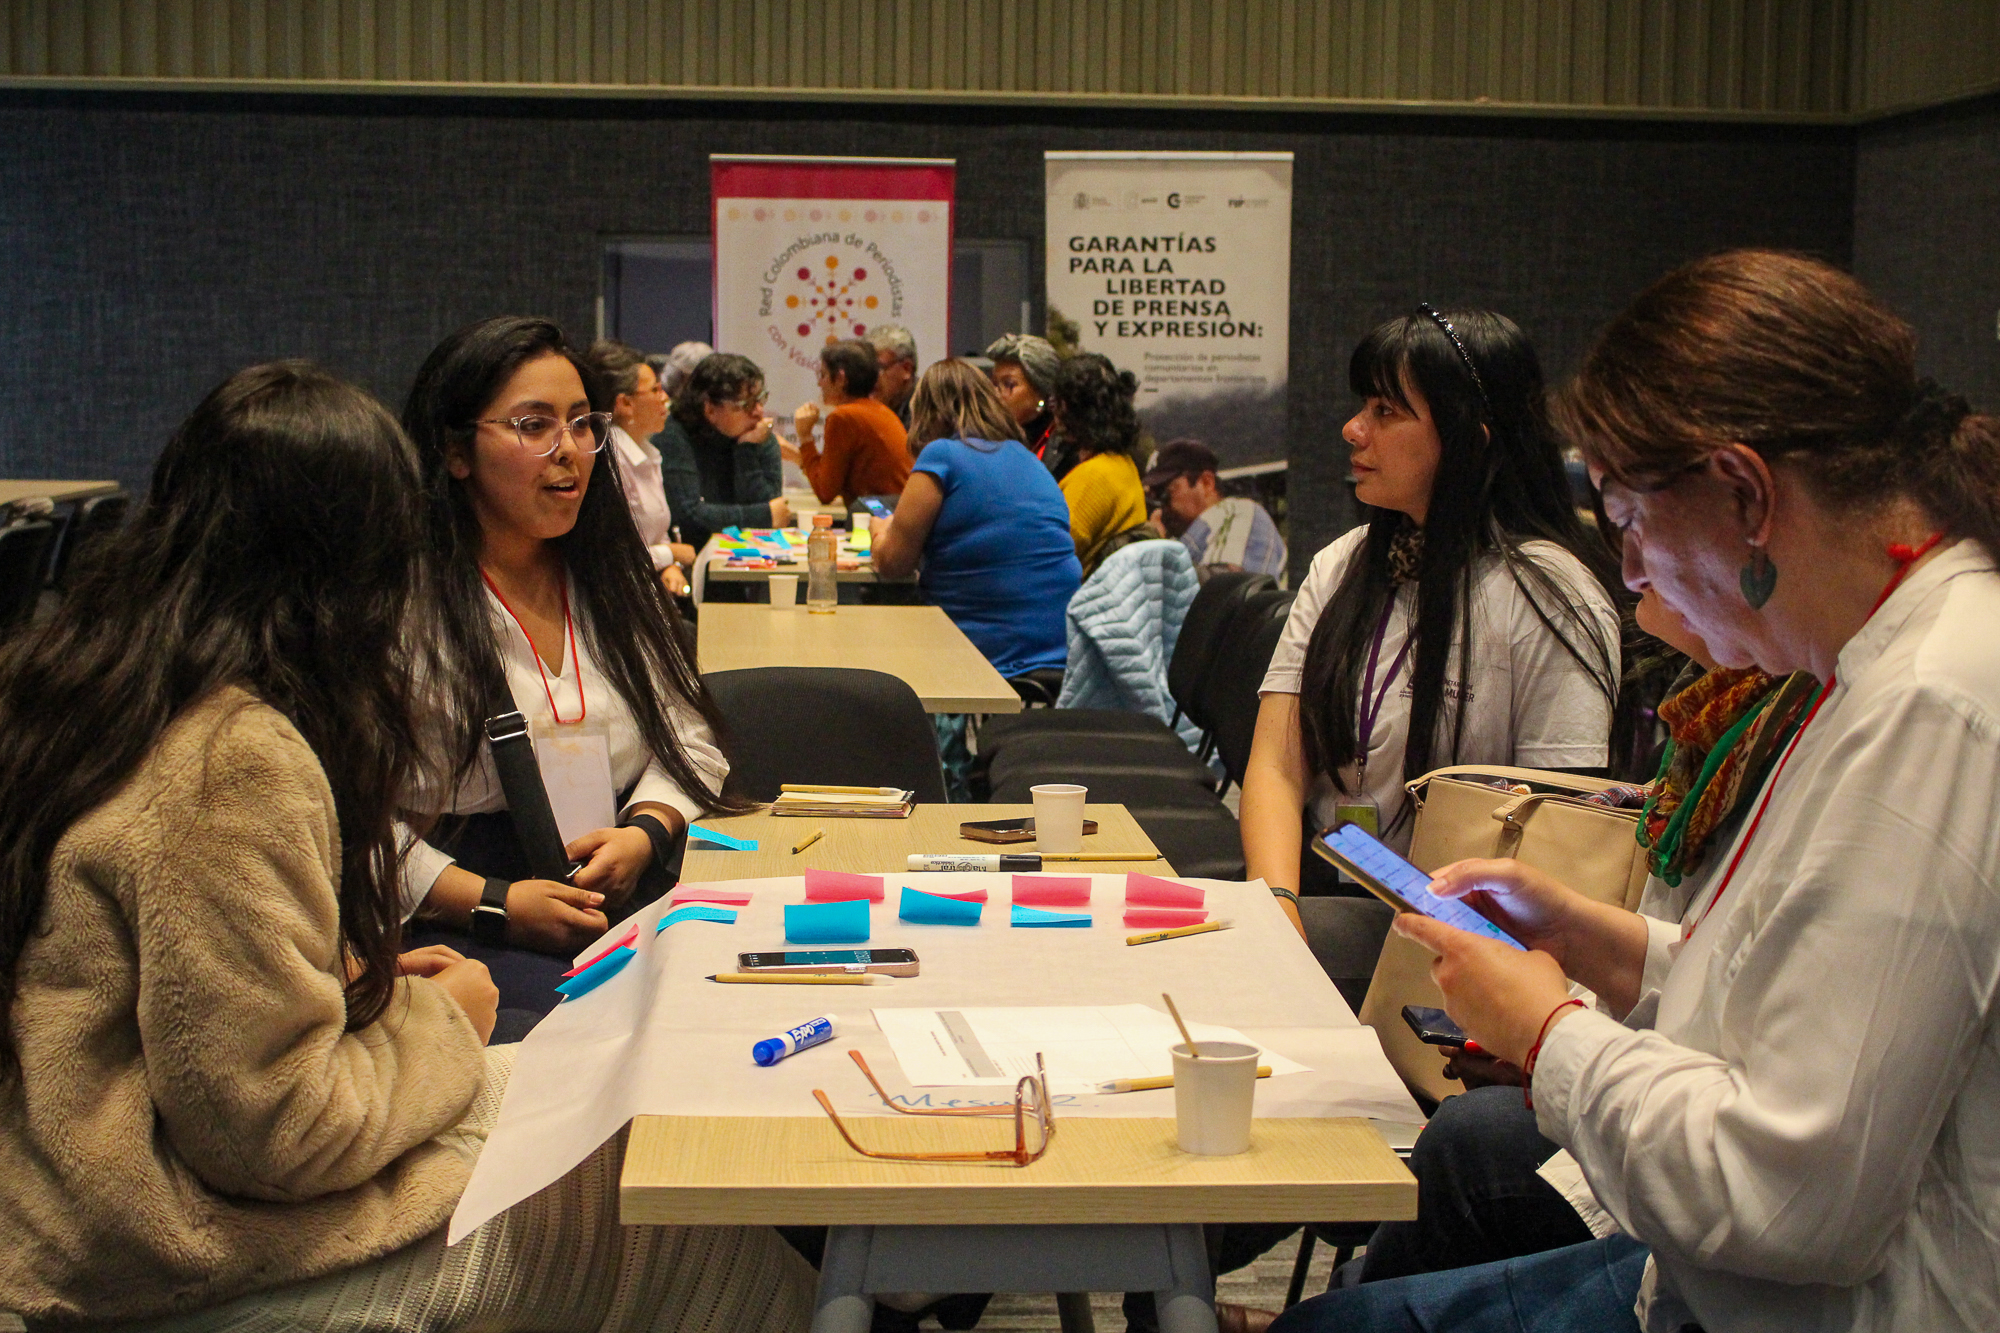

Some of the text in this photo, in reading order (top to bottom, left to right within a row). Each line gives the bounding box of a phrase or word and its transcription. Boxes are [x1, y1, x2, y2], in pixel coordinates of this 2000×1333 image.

[1069, 232, 1217, 253] GARANTÍAS
[759, 232, 905, 318] Red Colombiana de Periodistas
[1070, 257, 1174, 273] PARA LA
[1107, 279, 1226, 295] LIBERTAD
[1094, 300, 1231, 316] DE PRENSA
[1094, 315, 1264, 338] Y EXPRESIÓN:
[767, 324, 788, 351] con
[1444, 688, 1475, 703] MUER
[791, 1024, 815, 1045] EXPO
